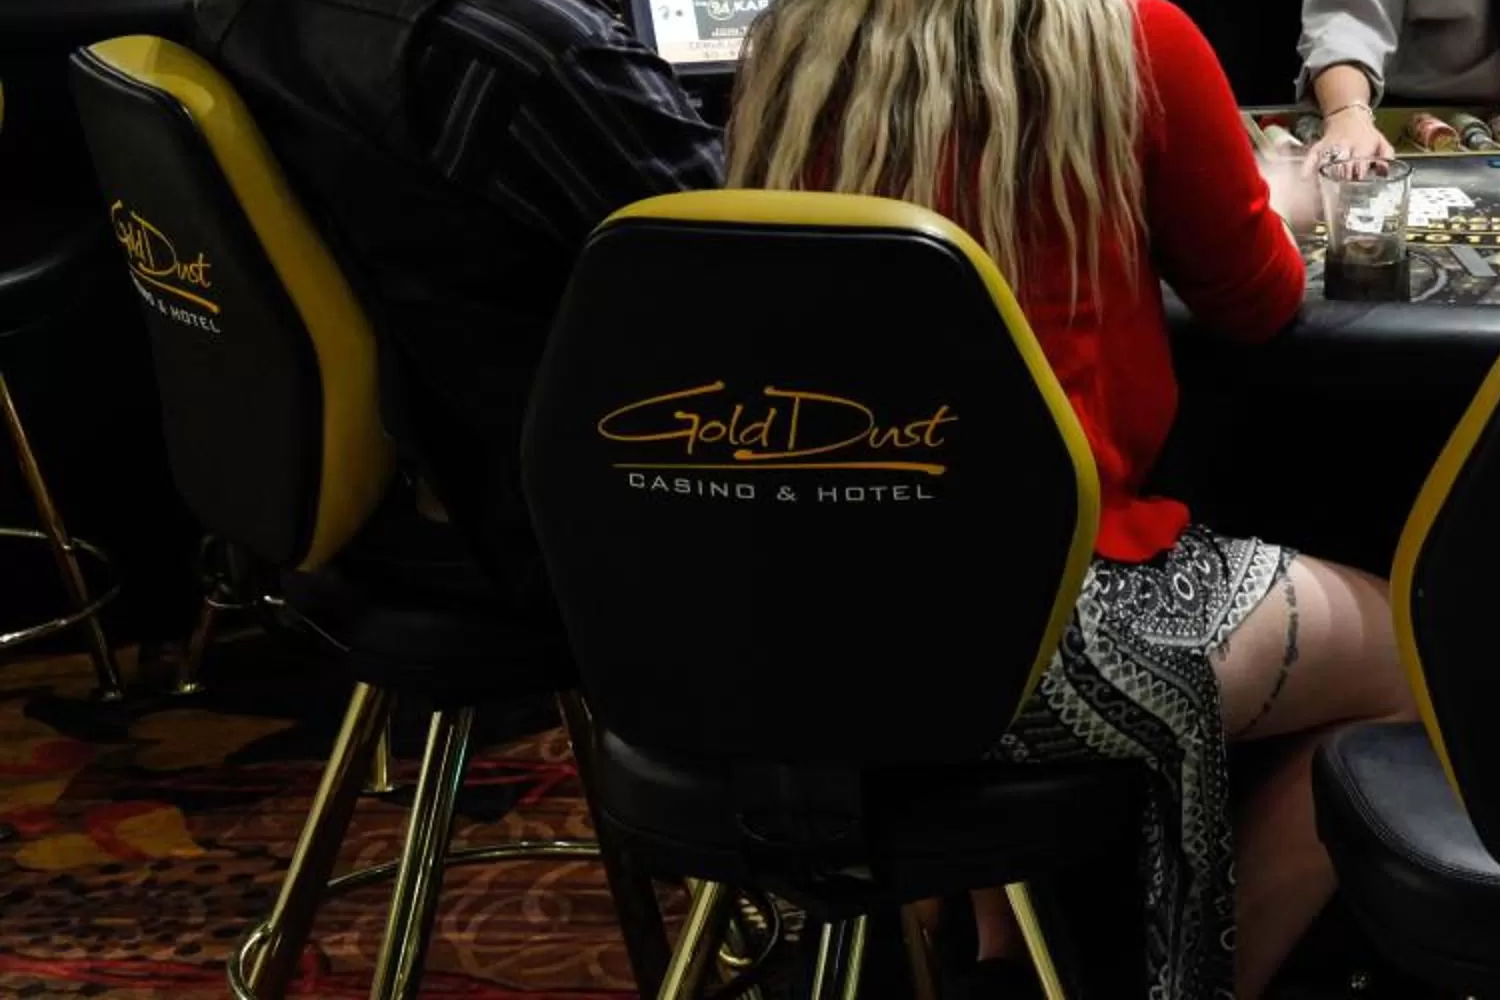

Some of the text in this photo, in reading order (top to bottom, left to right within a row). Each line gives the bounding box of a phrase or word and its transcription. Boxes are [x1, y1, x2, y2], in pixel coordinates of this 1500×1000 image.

[130, 210, 212, 288] Dust
[597, 380, 959, 461] Gold Dust
[628, 472, 937, 502] CASINO & HOTEL
